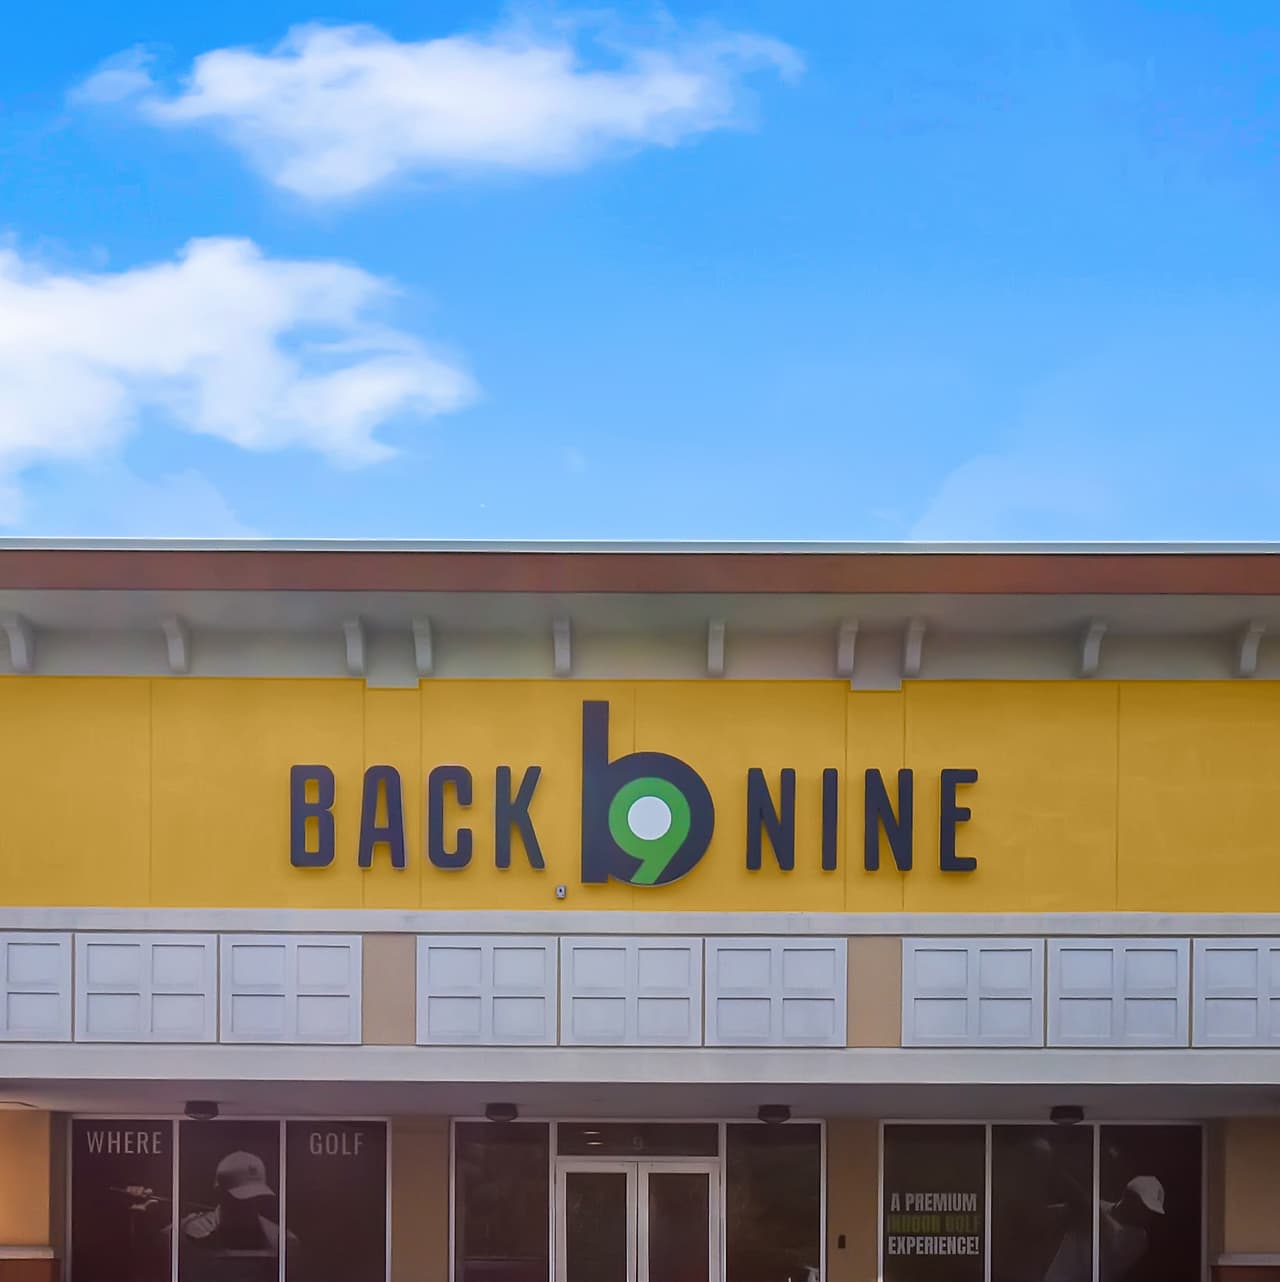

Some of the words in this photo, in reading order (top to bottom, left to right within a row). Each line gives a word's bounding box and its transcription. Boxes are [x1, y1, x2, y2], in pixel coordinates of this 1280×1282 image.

[289, 764, 546, 870] BACK
[745, 767, 979, 872] NINE
[86, 1130, 163, 1155] WHERE
[309, 1132, 366, 1156] GOLF
[890, 1193, 901, 1212] A
[905, 1193, 978, 1212] PREMIUM
[888, 1236, 980, 1256] EXPERIENCE!
